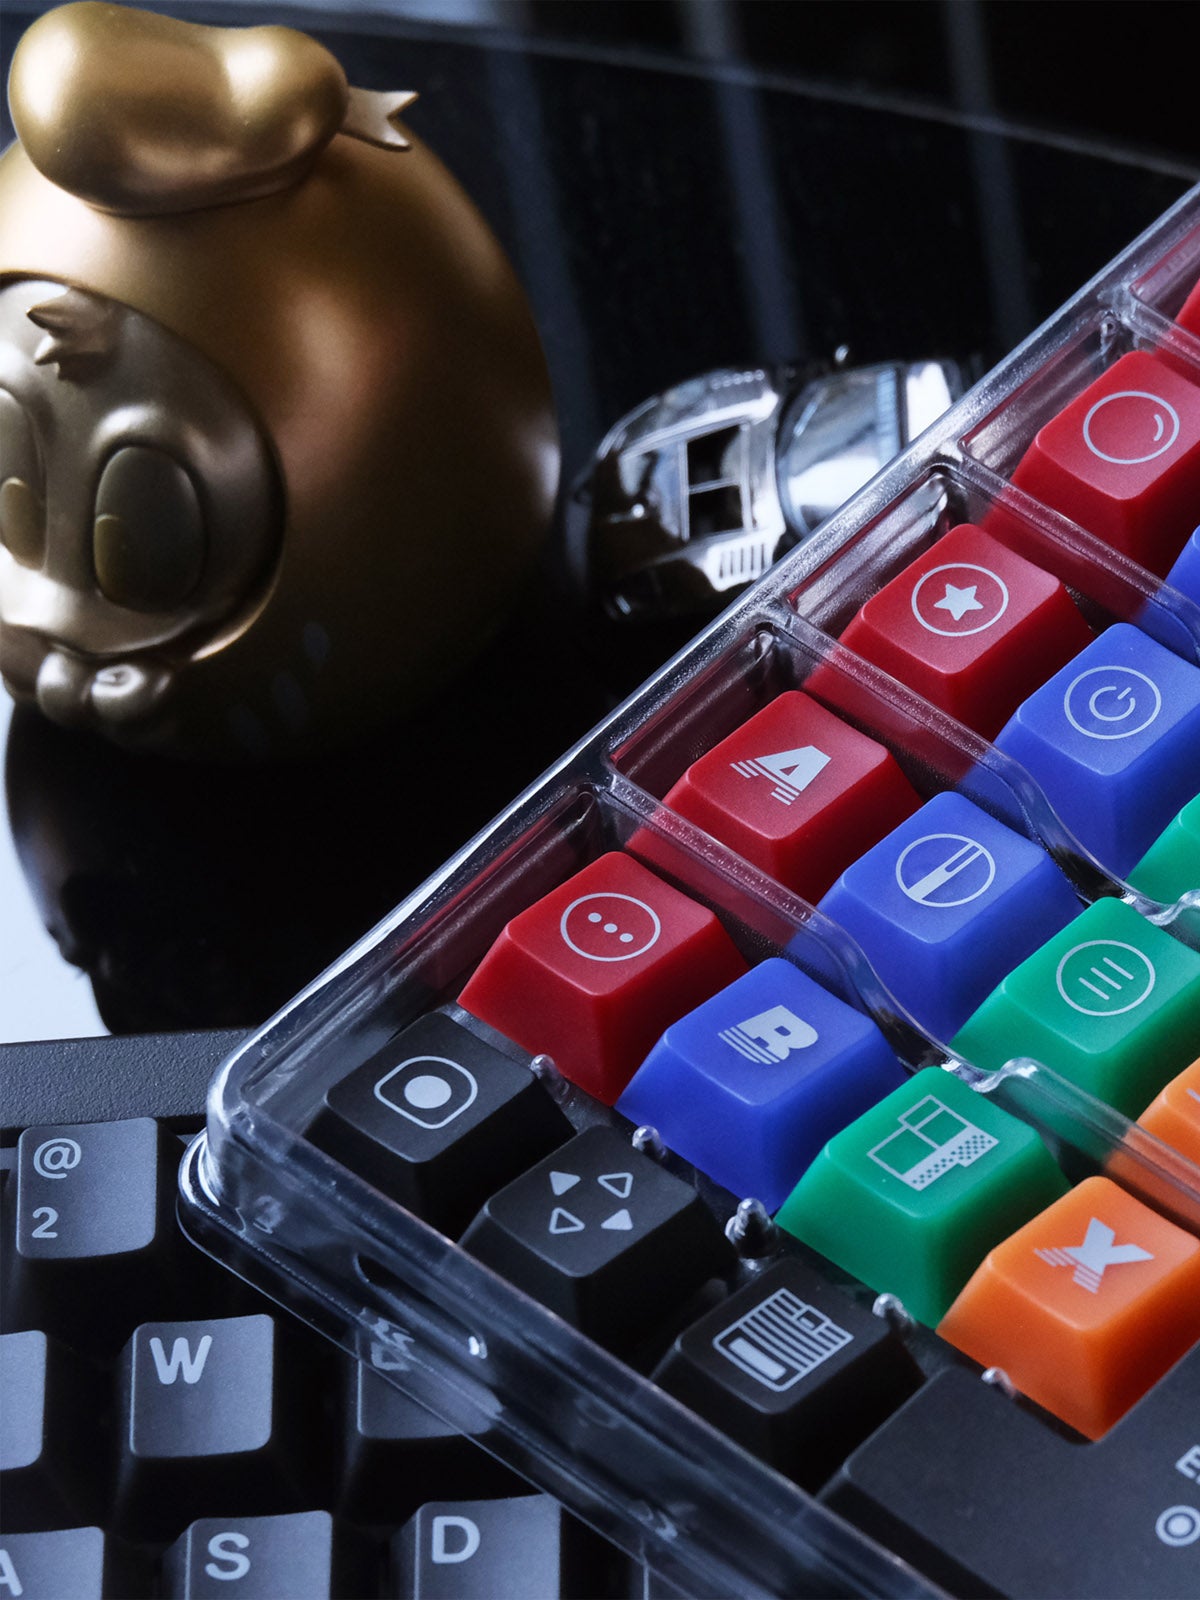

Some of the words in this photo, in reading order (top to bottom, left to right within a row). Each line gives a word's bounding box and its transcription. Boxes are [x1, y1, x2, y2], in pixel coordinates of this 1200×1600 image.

[731, 745, 831, 805] A
[718, 1005, 818, 1064] B
[33, 1138, 82, 1179] @
[31, 1207, 59, 1238] 2
[1034, 1217, 1155, 1294] X
[150, 1335, 213, 1385] W
[205, 1532, 250, 1581] S
[432, 1516, 481, 1564] D
